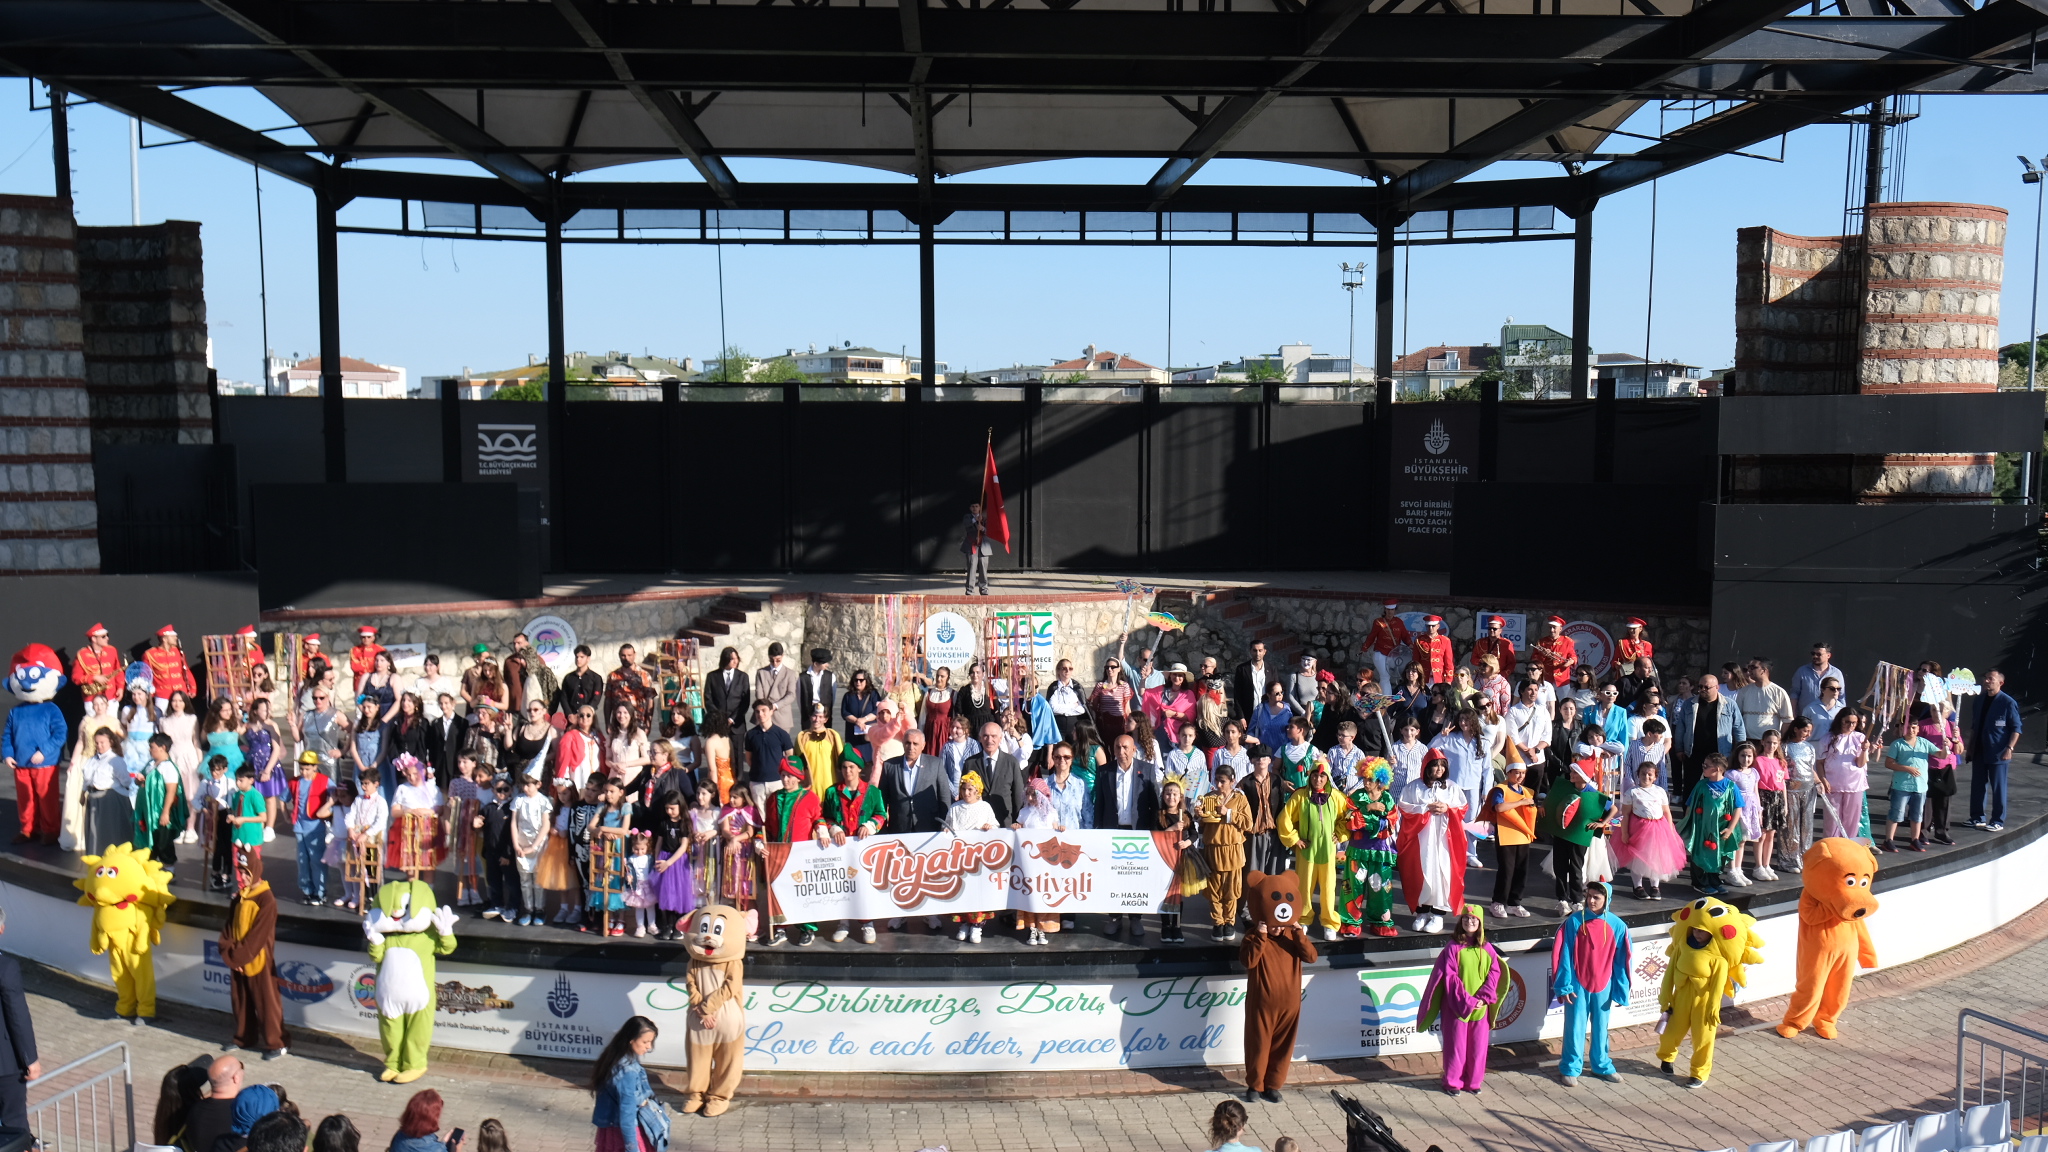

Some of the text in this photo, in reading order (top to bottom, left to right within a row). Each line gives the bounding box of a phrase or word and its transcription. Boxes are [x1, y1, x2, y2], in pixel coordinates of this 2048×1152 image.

[1404, 464, 1468, 475] BÜYÜKŞEHİR
[1400, 500, 1422, 508] SEVGİ
[926, 650, 970, 659] ÜYÜKŞEHİR
[859, 838, 1014, 910] Tiyatro
[989, 865, 1092, 907] Festivali
[1121, 898, 1149, 907] AKGÜN
[769, 980, 981, 1025] Birbirimize,
[536, 1021, 591, 1032] İSTANBUL
[525, 1029, 604, 1046] BÜYÜKŞEHİR
[744, 1021, 1225, 1065] Love to each other, peace for all
[1361, 1035, 1408, 1048] BELEDİYESİ
[537, 1043, 591, 1054] BELEDİYESİ
